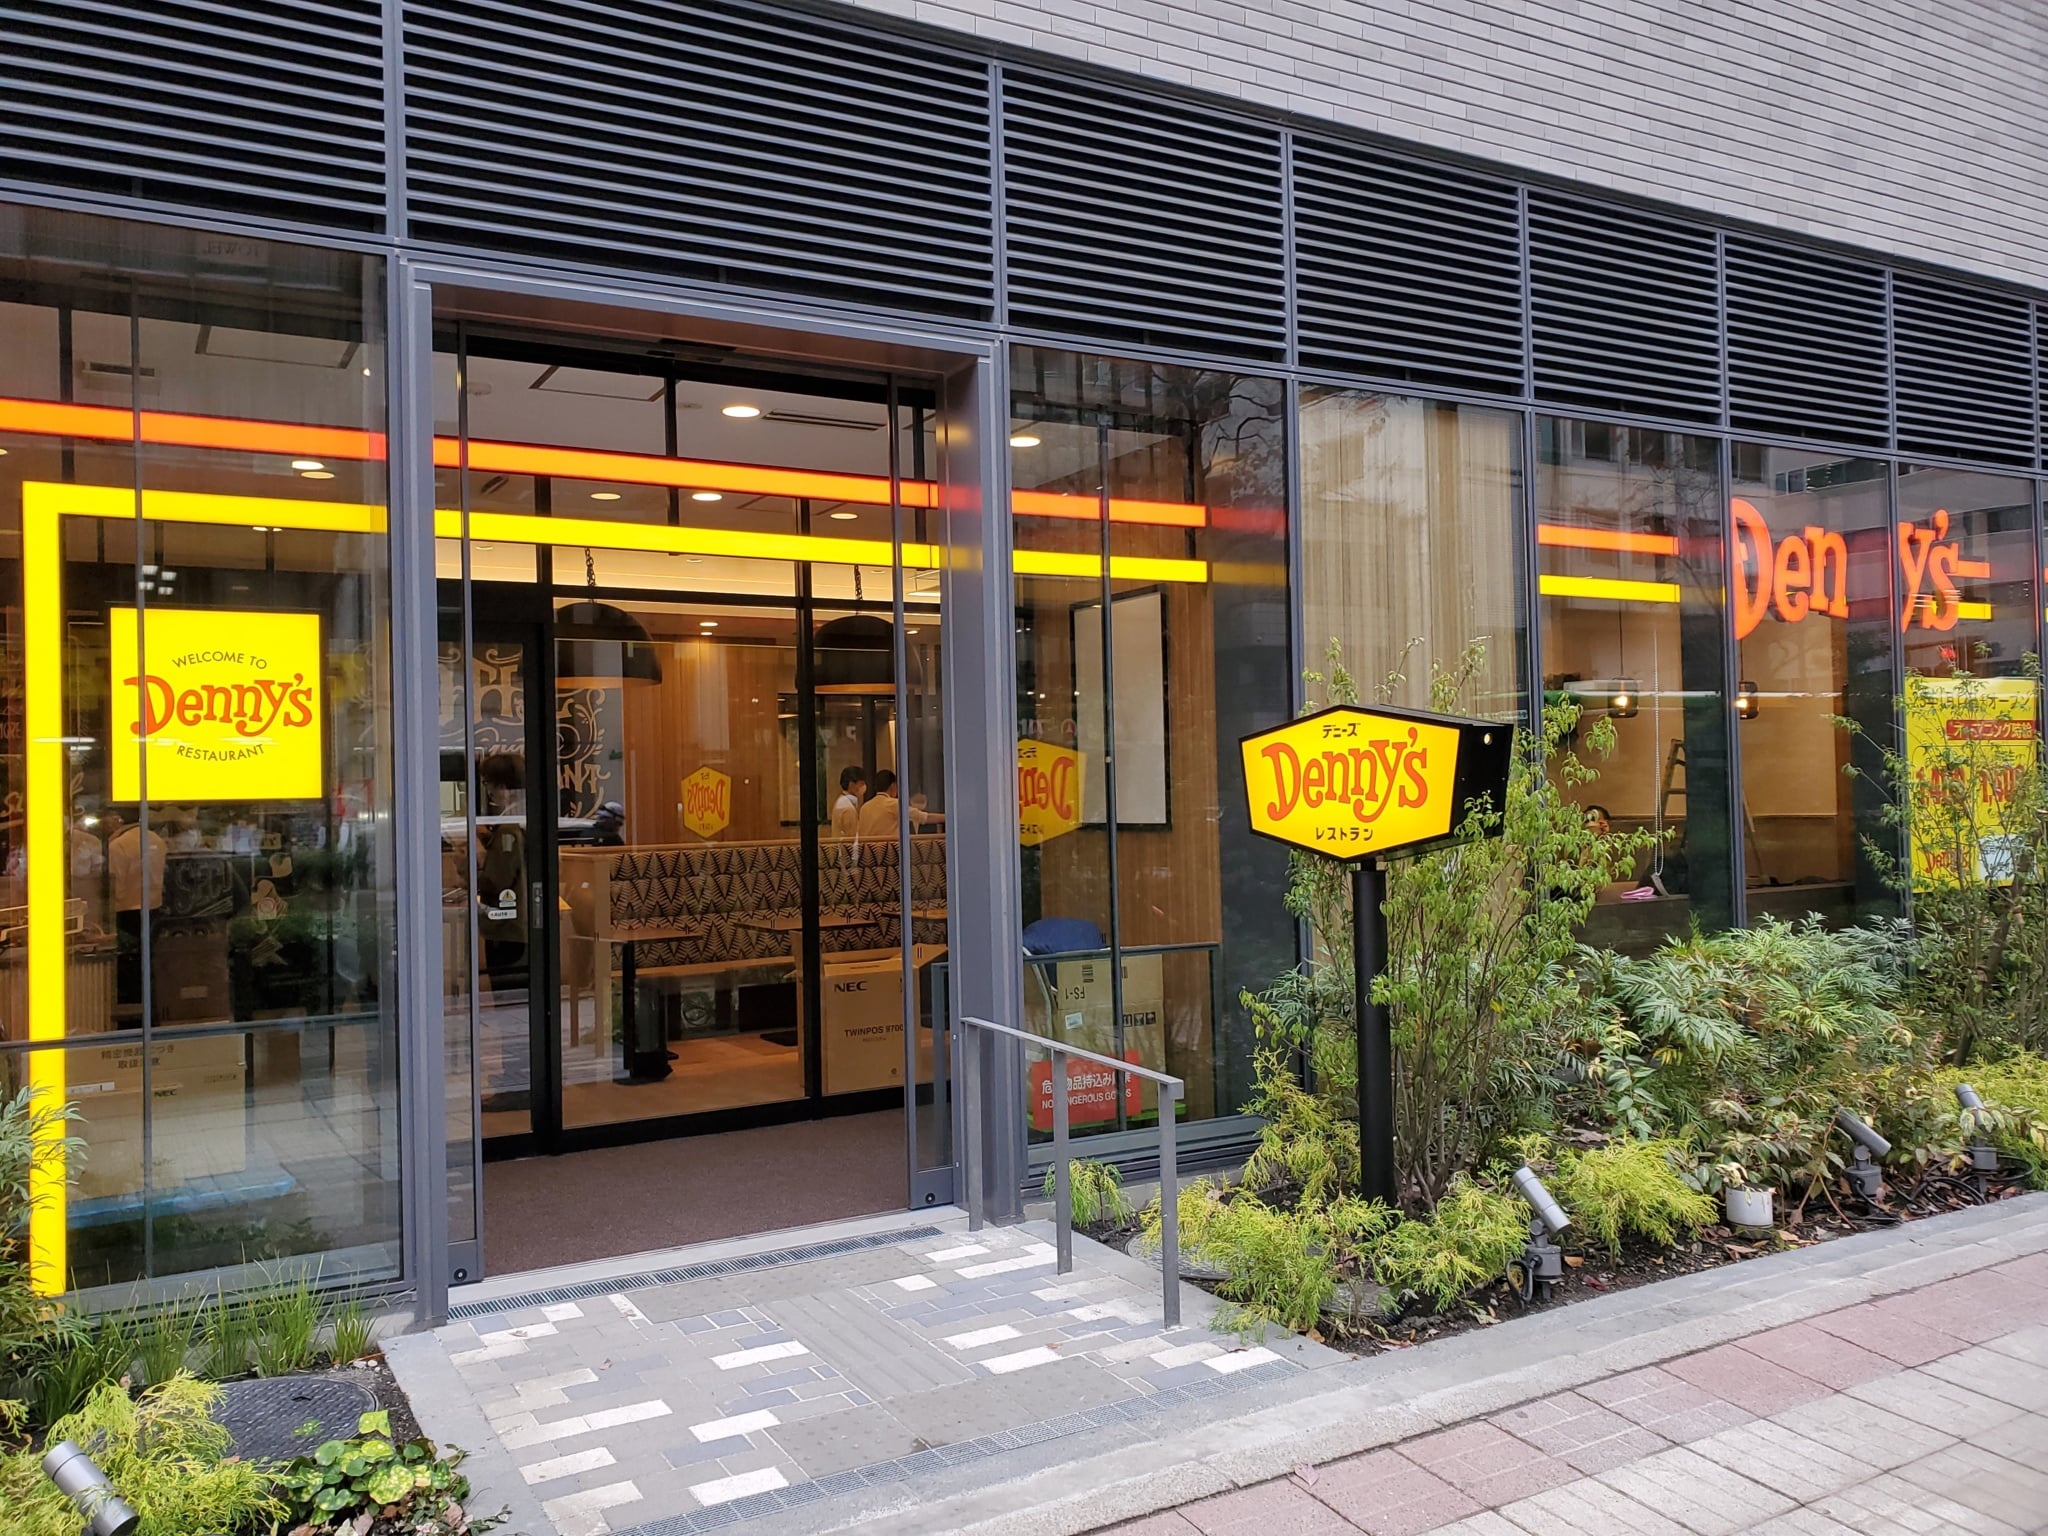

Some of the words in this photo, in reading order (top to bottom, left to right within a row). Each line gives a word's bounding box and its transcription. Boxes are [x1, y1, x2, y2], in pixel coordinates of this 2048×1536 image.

[172, 651, 245, 669] WELCOME
[249, 655, 268, 669] TO
[123, 673, 313, 737] Denny's
[1322, 723, 1361, 739] デニーズ
[176, 743, 265, 761] RESTAURANT
[1261, 727, 1428, 823] Denny's
[1315, 827, 1374, 841] レストラン
[834, 981, 868, 992] NEC
[1065, 986, 1086, 1001] FS-1
[844, 1025, 884, 1038] TWINPOS
[154, 1088, 177, 1097] NEC
